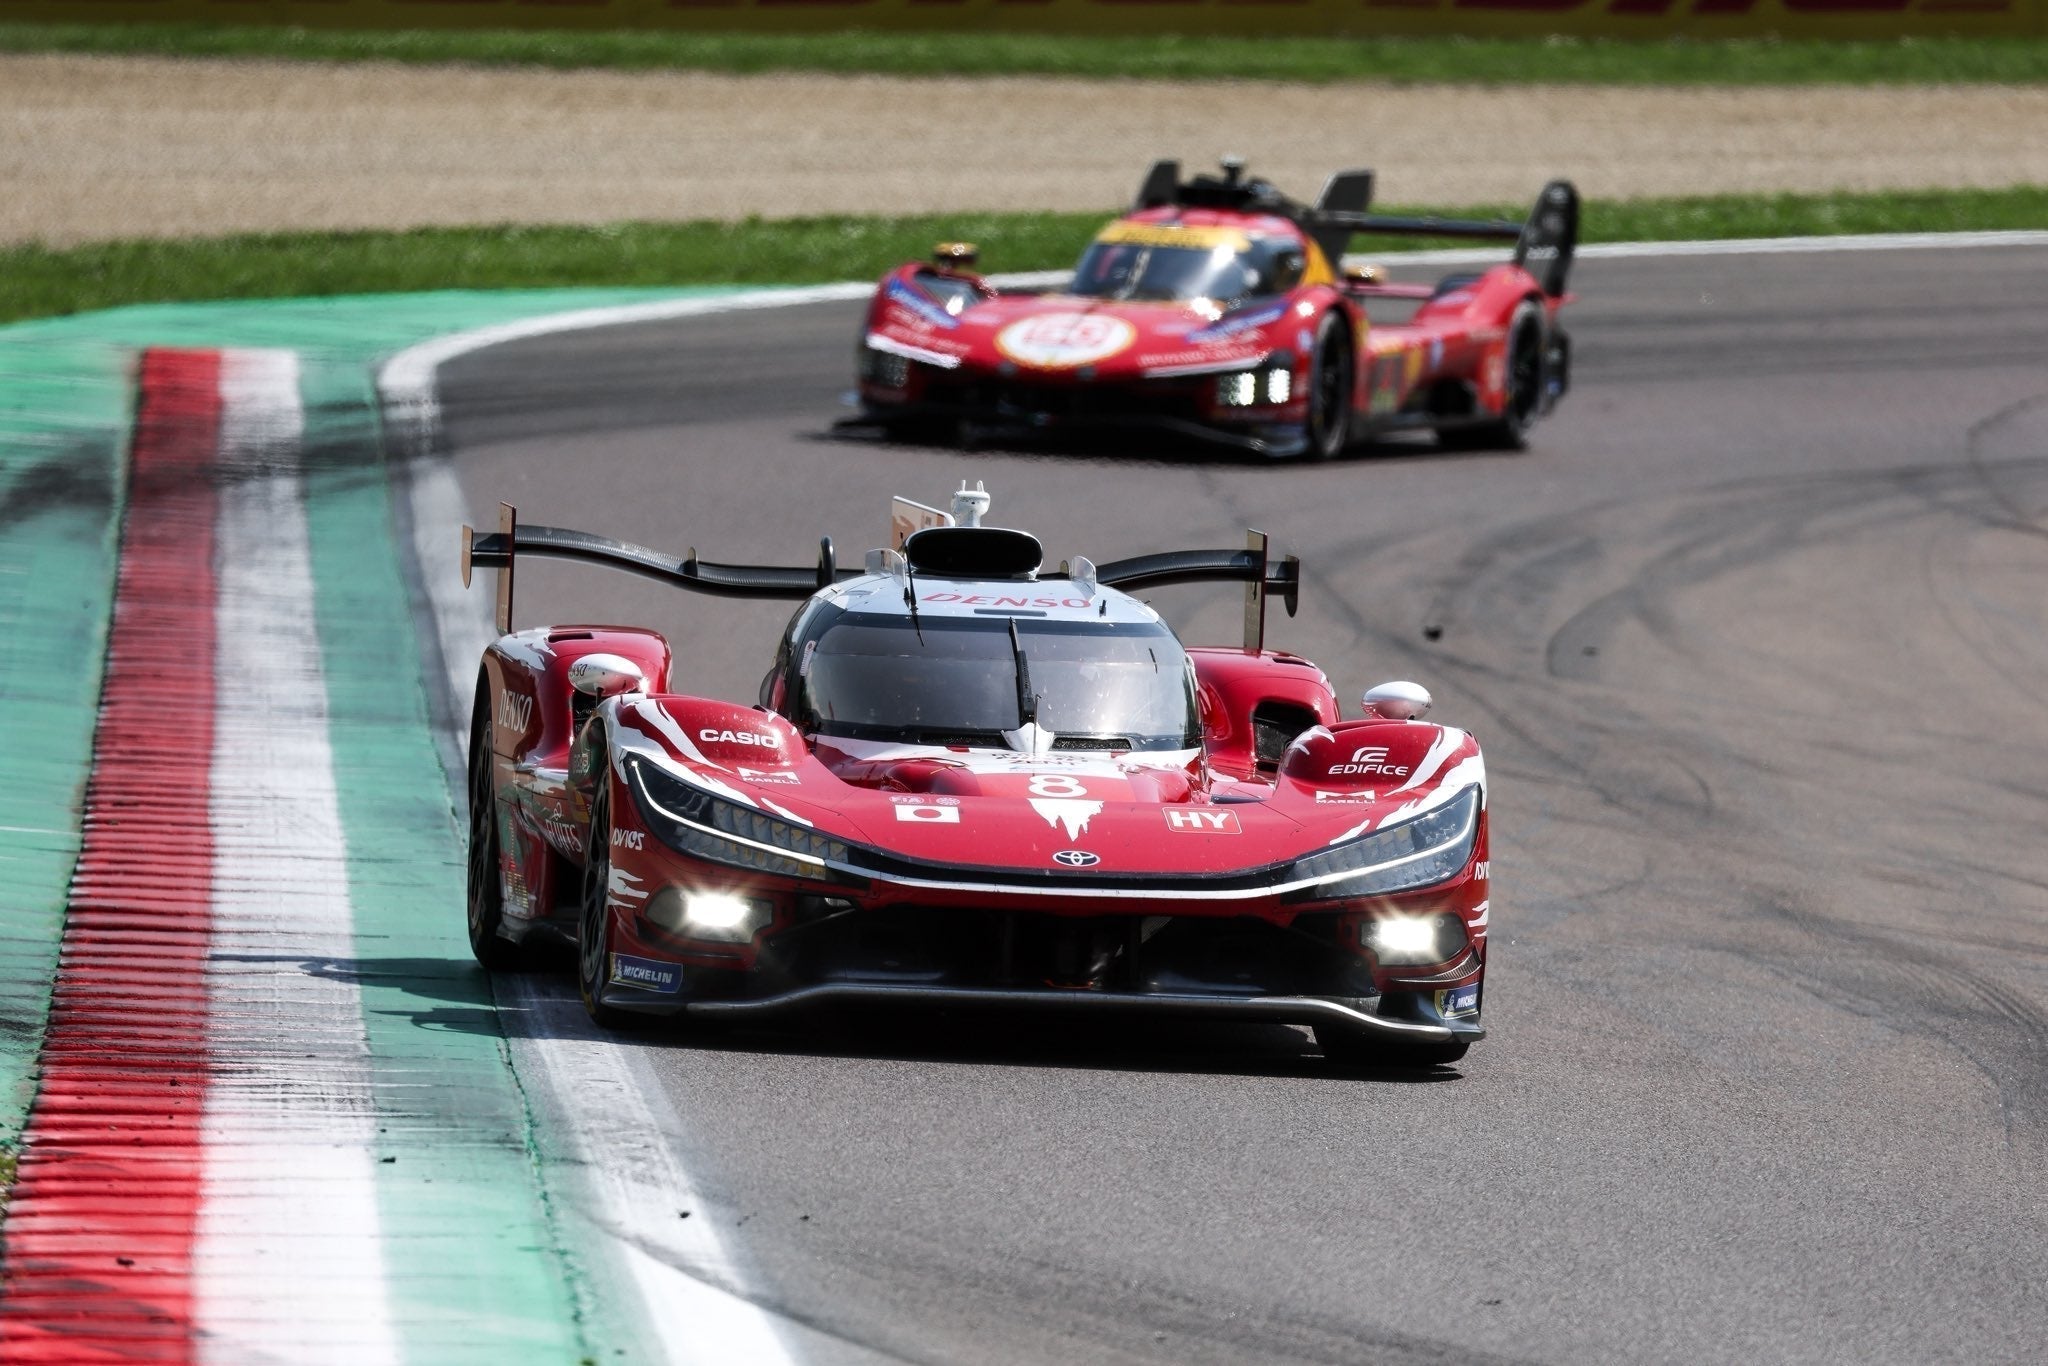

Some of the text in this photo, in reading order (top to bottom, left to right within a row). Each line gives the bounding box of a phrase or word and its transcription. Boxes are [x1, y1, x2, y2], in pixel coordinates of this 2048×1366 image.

[921, 593, 1092, 609] DENSO
[498, 689, 532, 734] DENSO
[700, 728, 779, 749] CASIO
[1328, 764, 1409, 776] EDIFICE
[743, 777, 801, 785] MARELLI
[1028, 774, 1088, 798] 8
[1169, 811, 1230, 829] HY
[623, 964, 673, 984] MICHELIN
